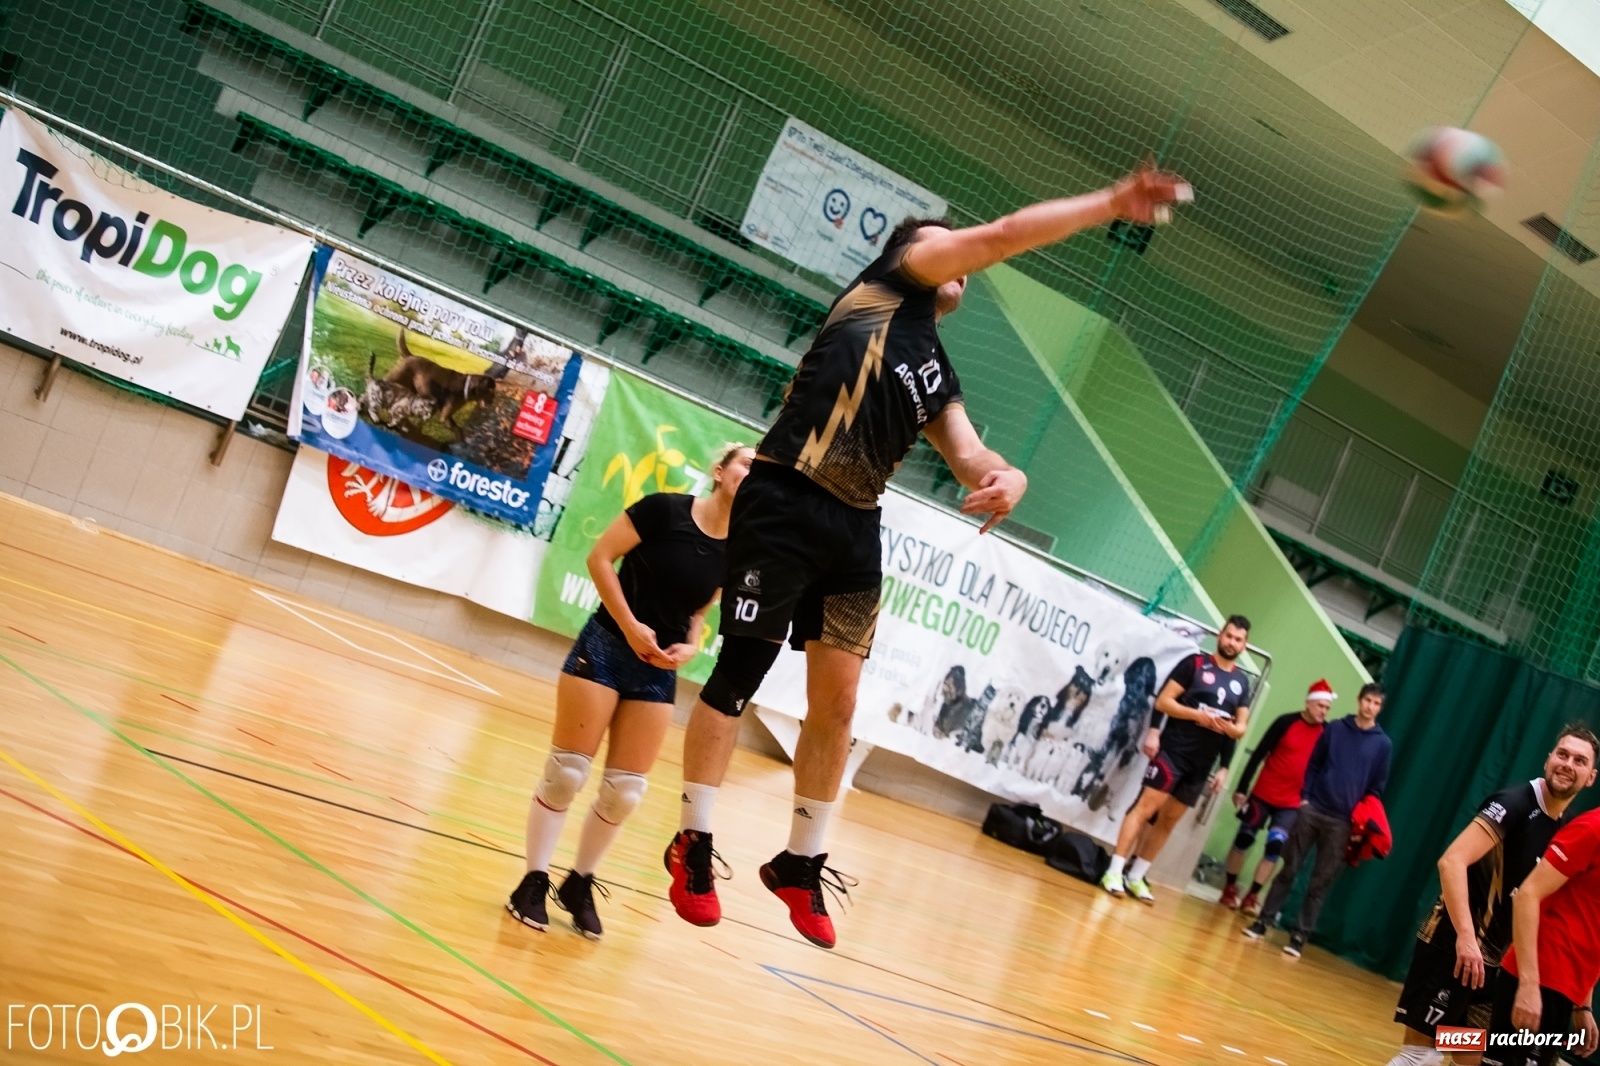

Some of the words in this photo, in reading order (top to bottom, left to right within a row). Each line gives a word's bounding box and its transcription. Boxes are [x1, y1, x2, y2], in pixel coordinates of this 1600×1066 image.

[12, 147, 263, 321] TropiDog
[333, 258, 375, 289] Przez
[374, 277, 430, 314] kolejne
[428, 304, 465, 331] pory
[464, 319, 495, 342] roku
[60, 326, 145, 366] www.tropidog.pl
[534, 393, 548, 413] 8
[449, 462, 530, 508] foresto
[735, 596, 759, 622] 10
[958, 560, 996, 608] DLA
[996, 581, 1091, 655] TWOJEGO
[1424, 1005, 1445, 1026] 17
